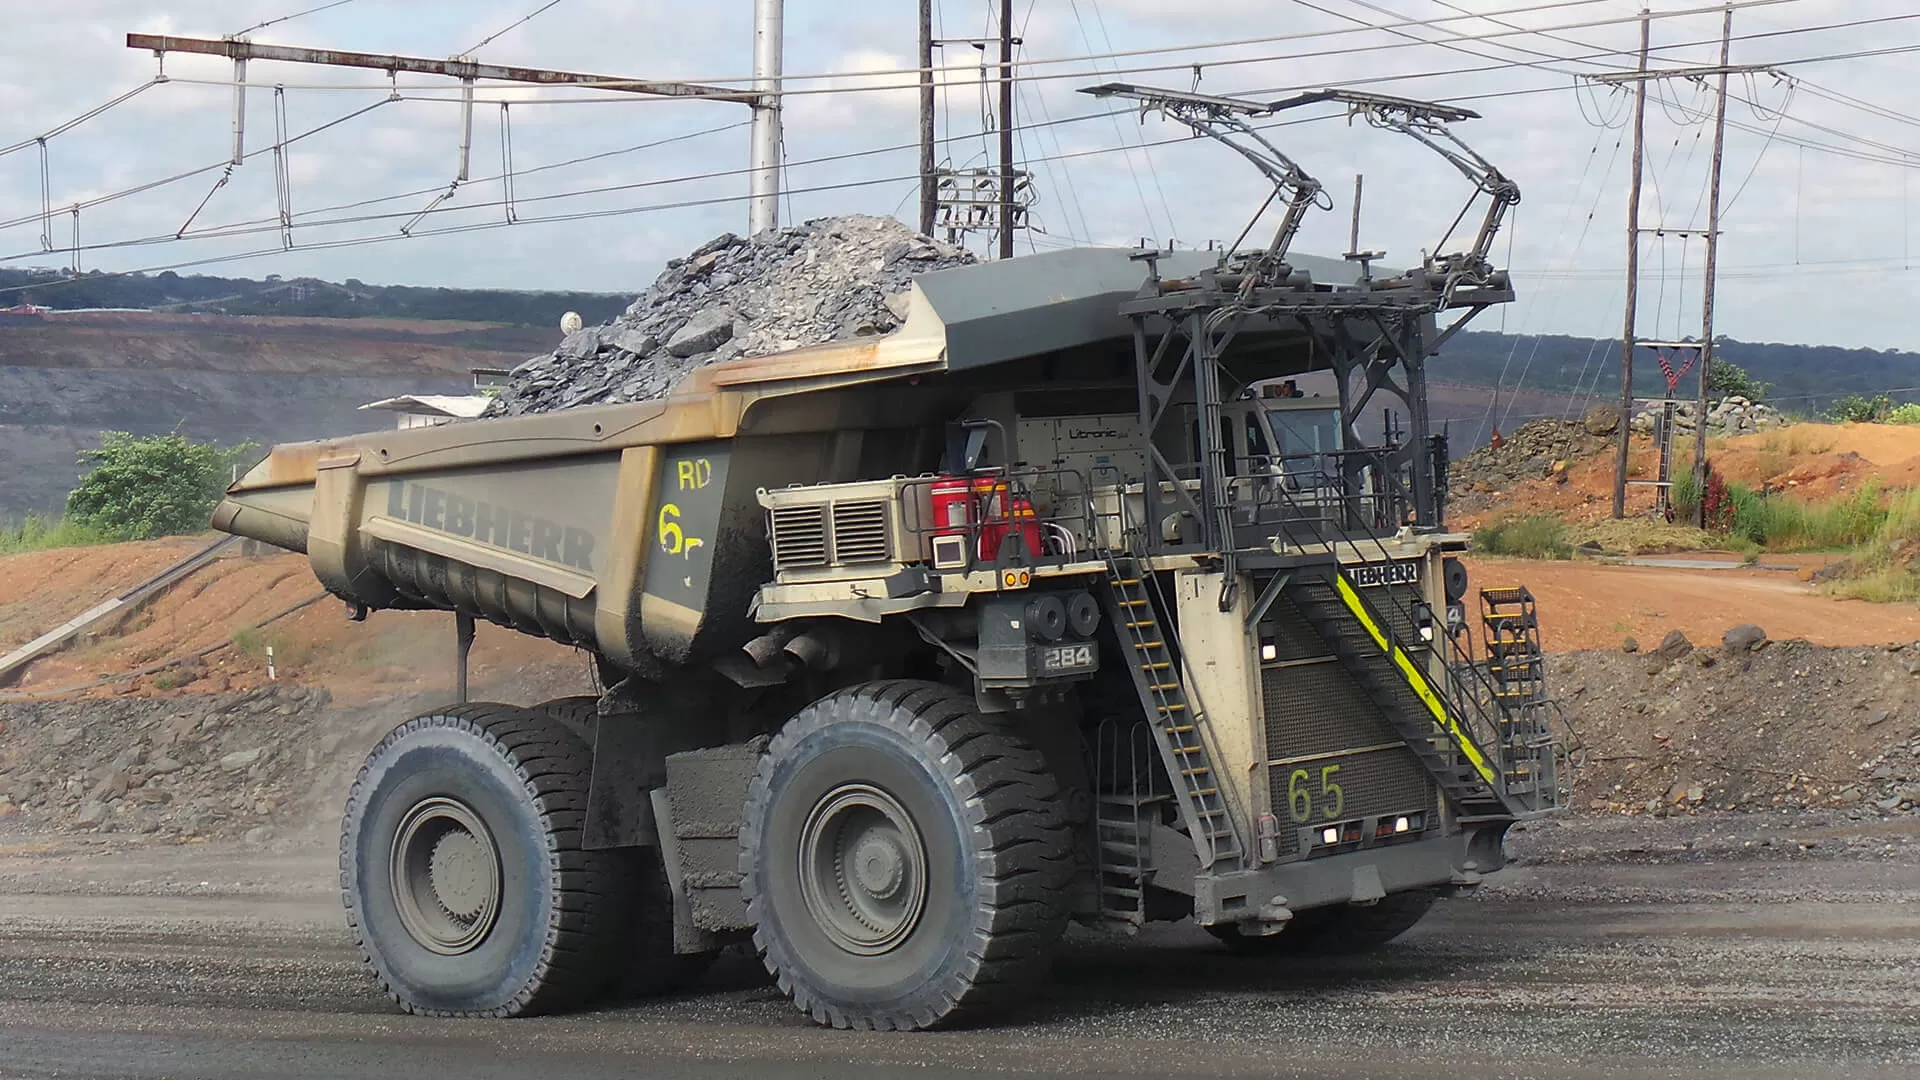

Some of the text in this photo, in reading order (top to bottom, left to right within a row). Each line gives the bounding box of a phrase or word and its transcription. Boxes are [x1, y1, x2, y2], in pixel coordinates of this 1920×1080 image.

[677, 458, 711, 490] RD
[388, 480, 594, 576] LIEBHERR
[1346, 564, 1416, 585] IEBHERR
[1044, 647, 1092, 669] 284
[1288, 764, 1344, 822] 65
